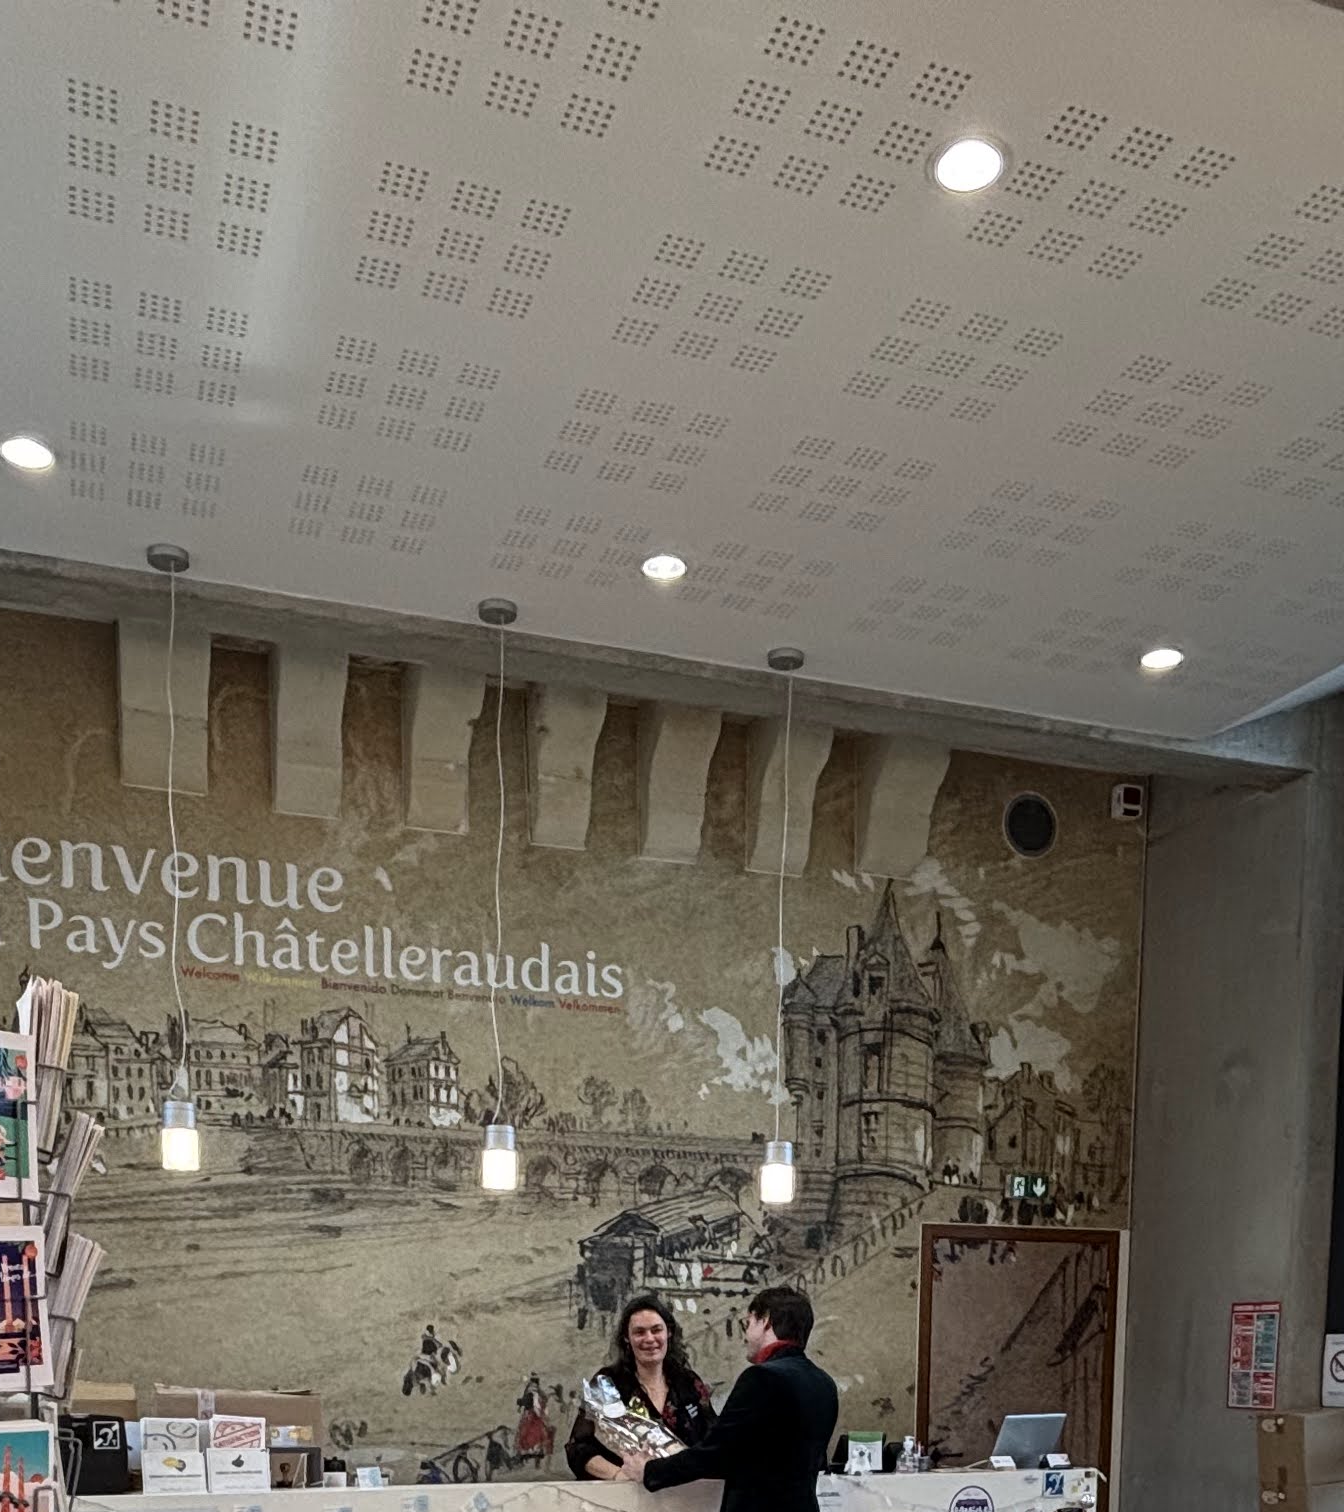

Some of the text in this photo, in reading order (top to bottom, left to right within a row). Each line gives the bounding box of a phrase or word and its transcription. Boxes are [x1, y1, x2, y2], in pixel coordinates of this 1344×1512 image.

[27, 897, 167, 970] Pays
[186, 912, 624, 999] Châtelleraudais
[180, 965, 241, 982] Welcome
[321, 977, 387, 994] Bienvenido
